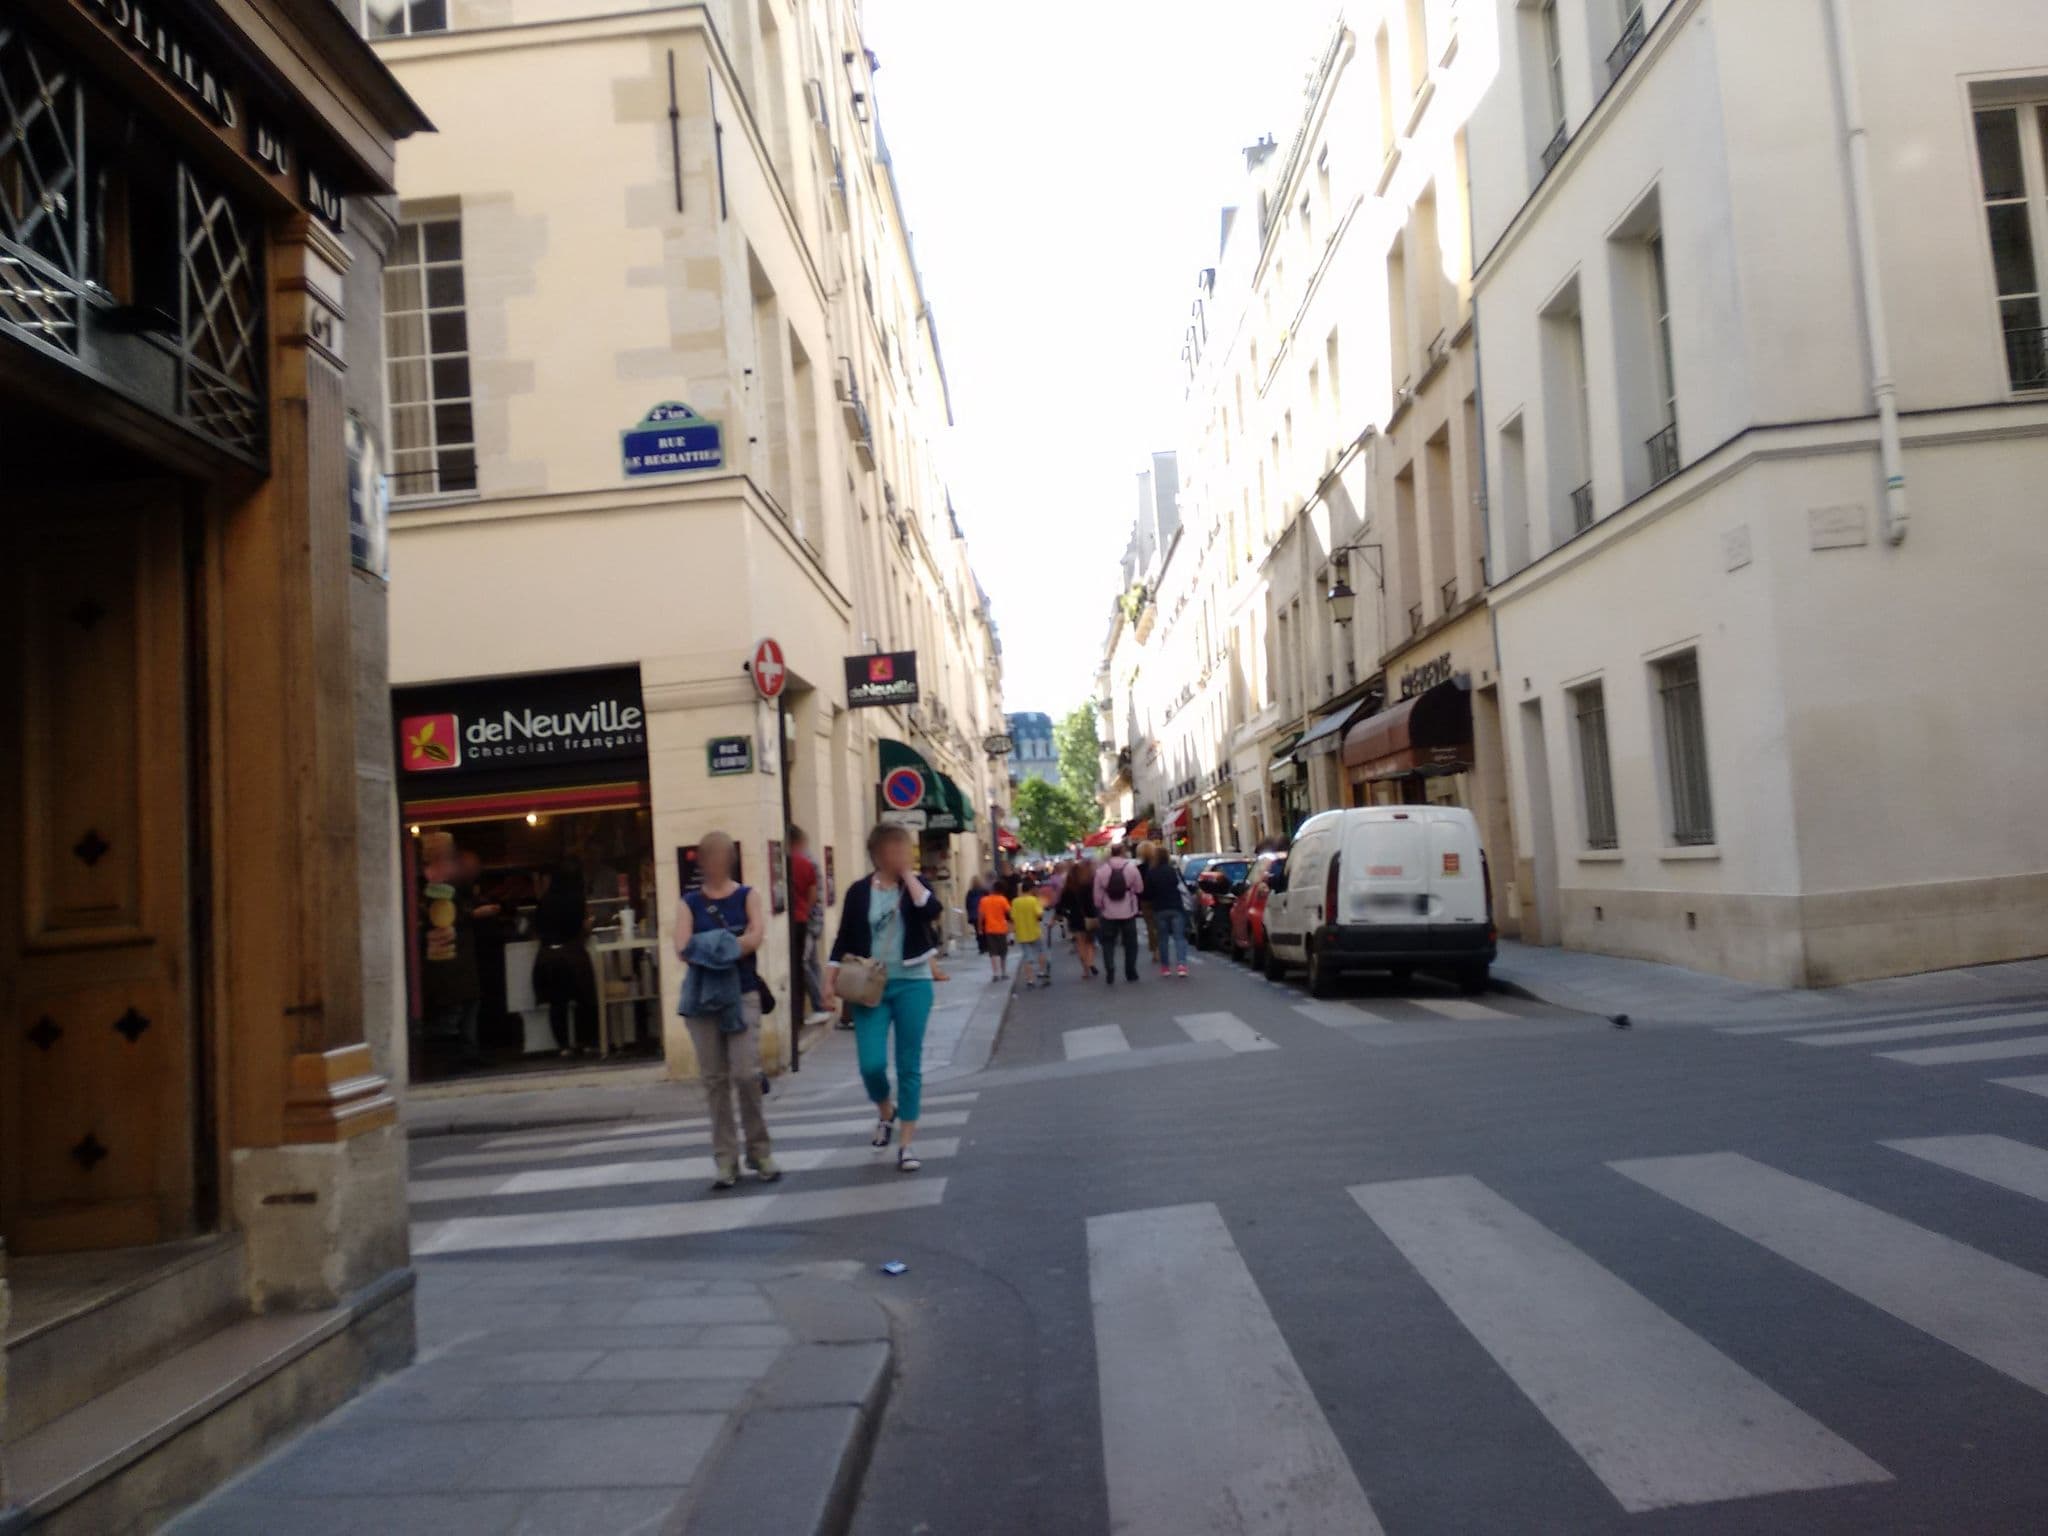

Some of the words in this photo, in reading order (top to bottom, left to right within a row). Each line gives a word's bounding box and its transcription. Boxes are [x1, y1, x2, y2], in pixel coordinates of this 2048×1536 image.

[658, 436, 686, 449] RUE
[466, 700, 643, 744] deNeuville
[564, 733, 643, 750] français
